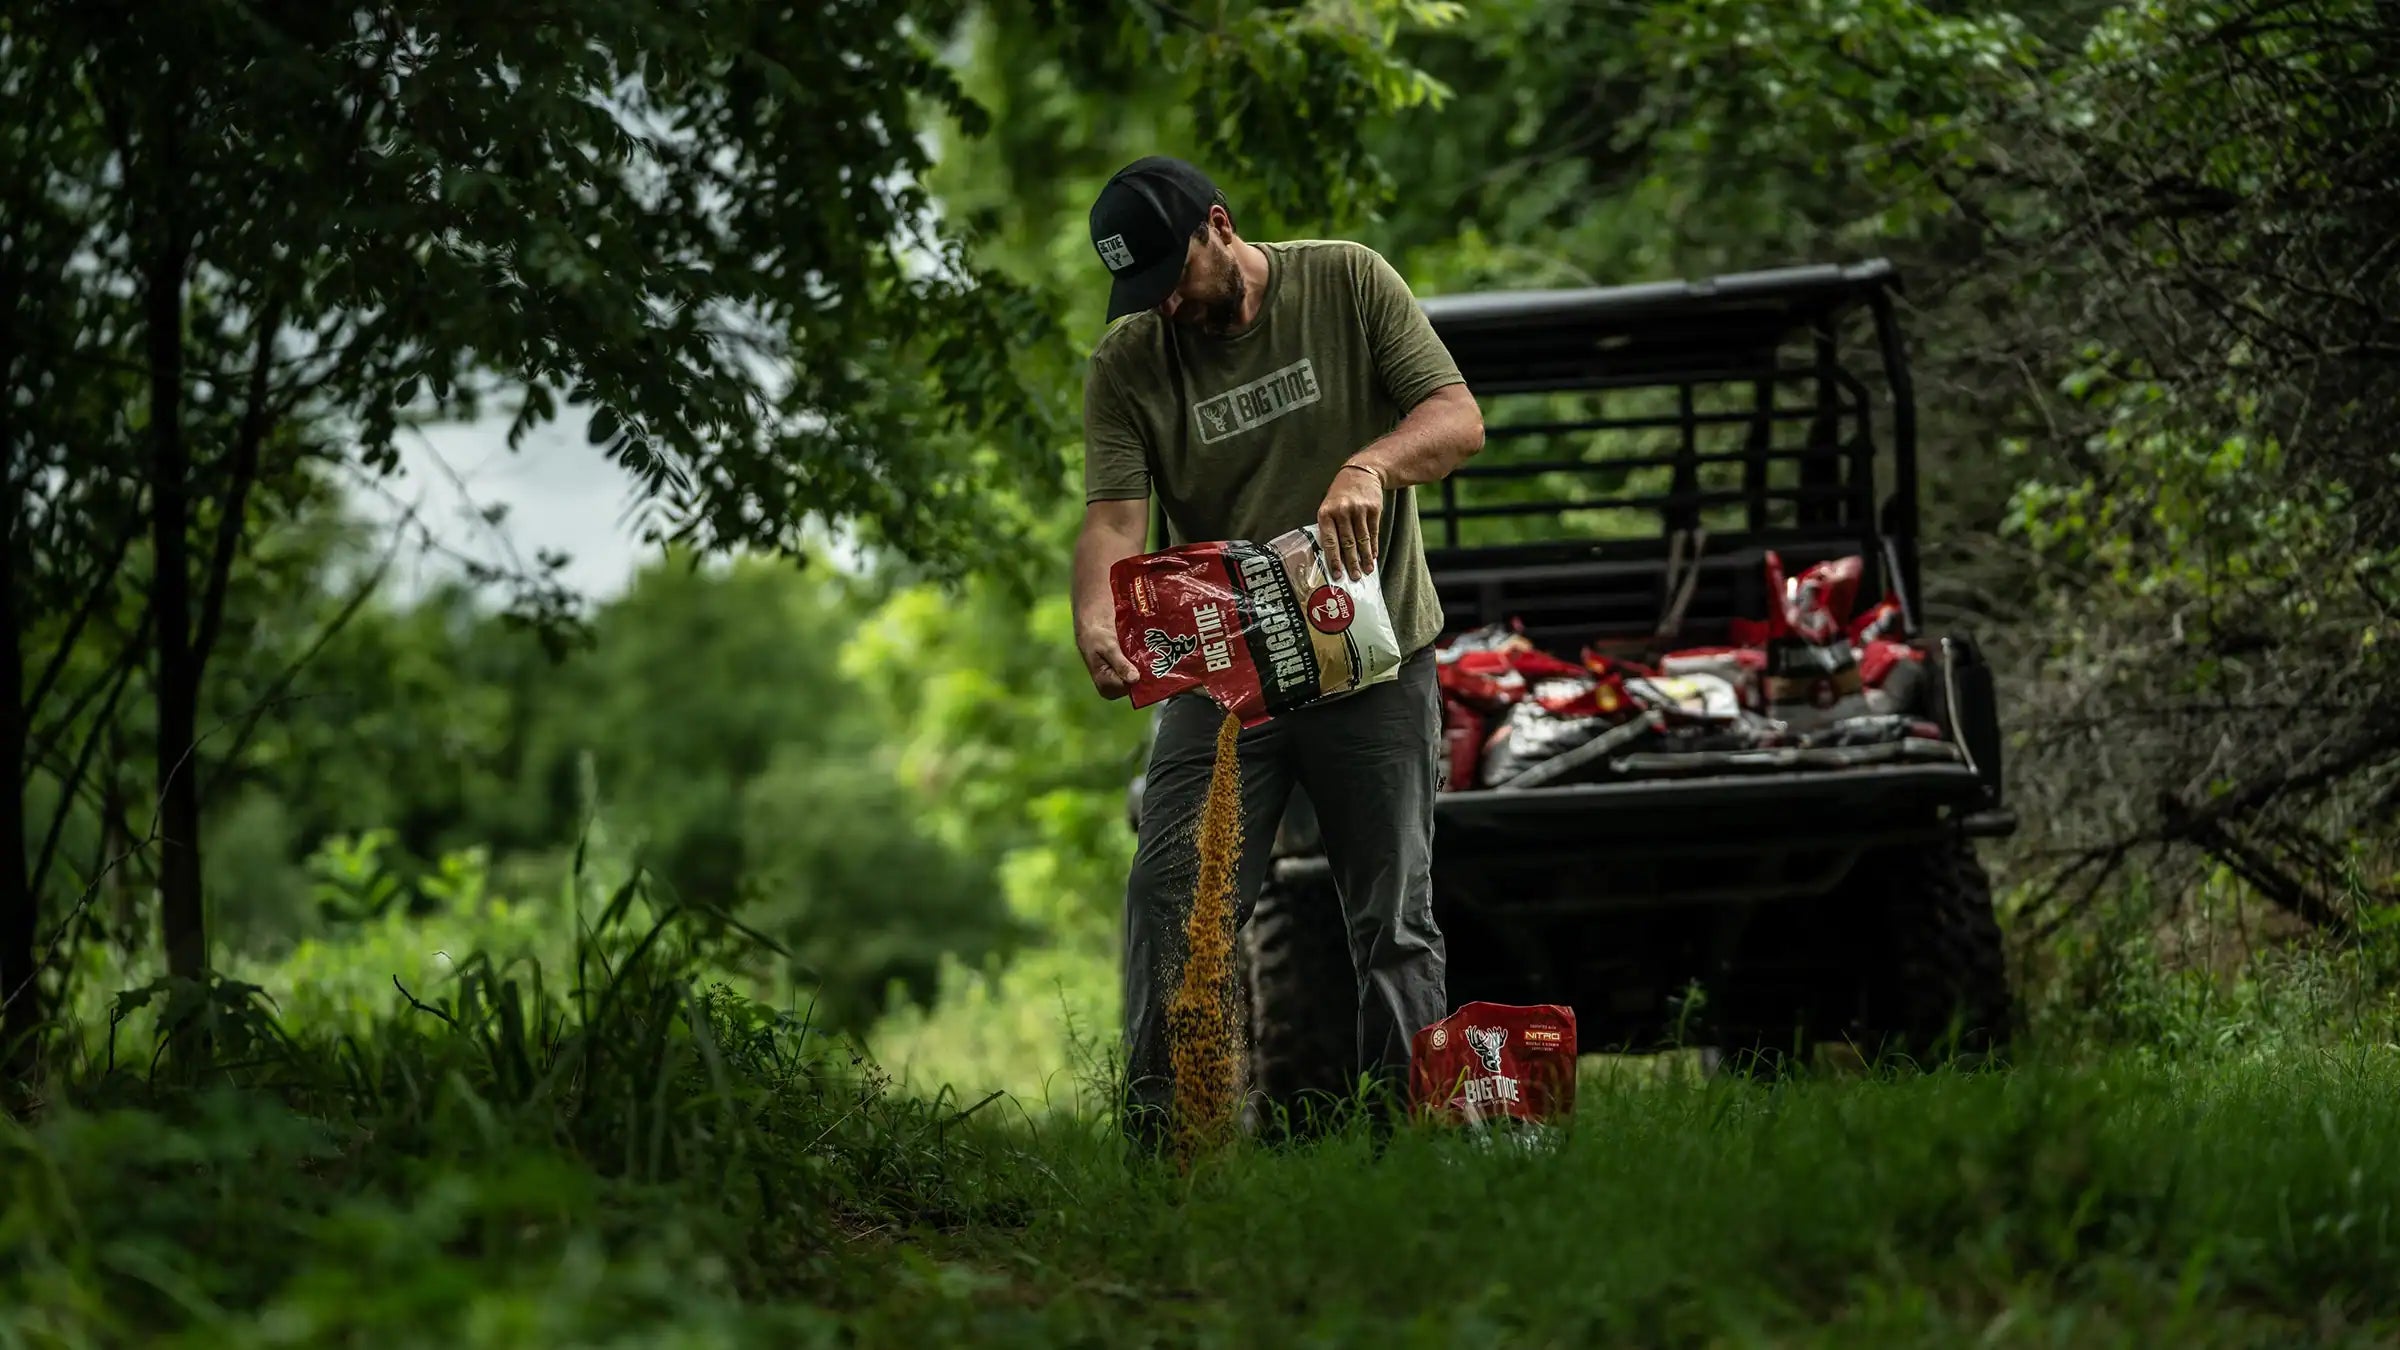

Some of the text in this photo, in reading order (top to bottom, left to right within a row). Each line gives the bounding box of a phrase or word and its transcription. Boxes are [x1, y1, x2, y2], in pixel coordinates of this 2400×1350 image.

[1236, 366, 1315, 422] BIG TINE
[1135, 576, 1150, 616] NITRO
[1335, 594, 1350, 619] CHERRY
[1193, 602, 1225, 644] TINE
[1240, 556, 1306, 693] TRIGGERED
[1202, 640, 1231, 672] BIG
[1525, 1031, 1560, 1041] NITRO
[1464, 1075, 1520, 1103] BIG TINE
